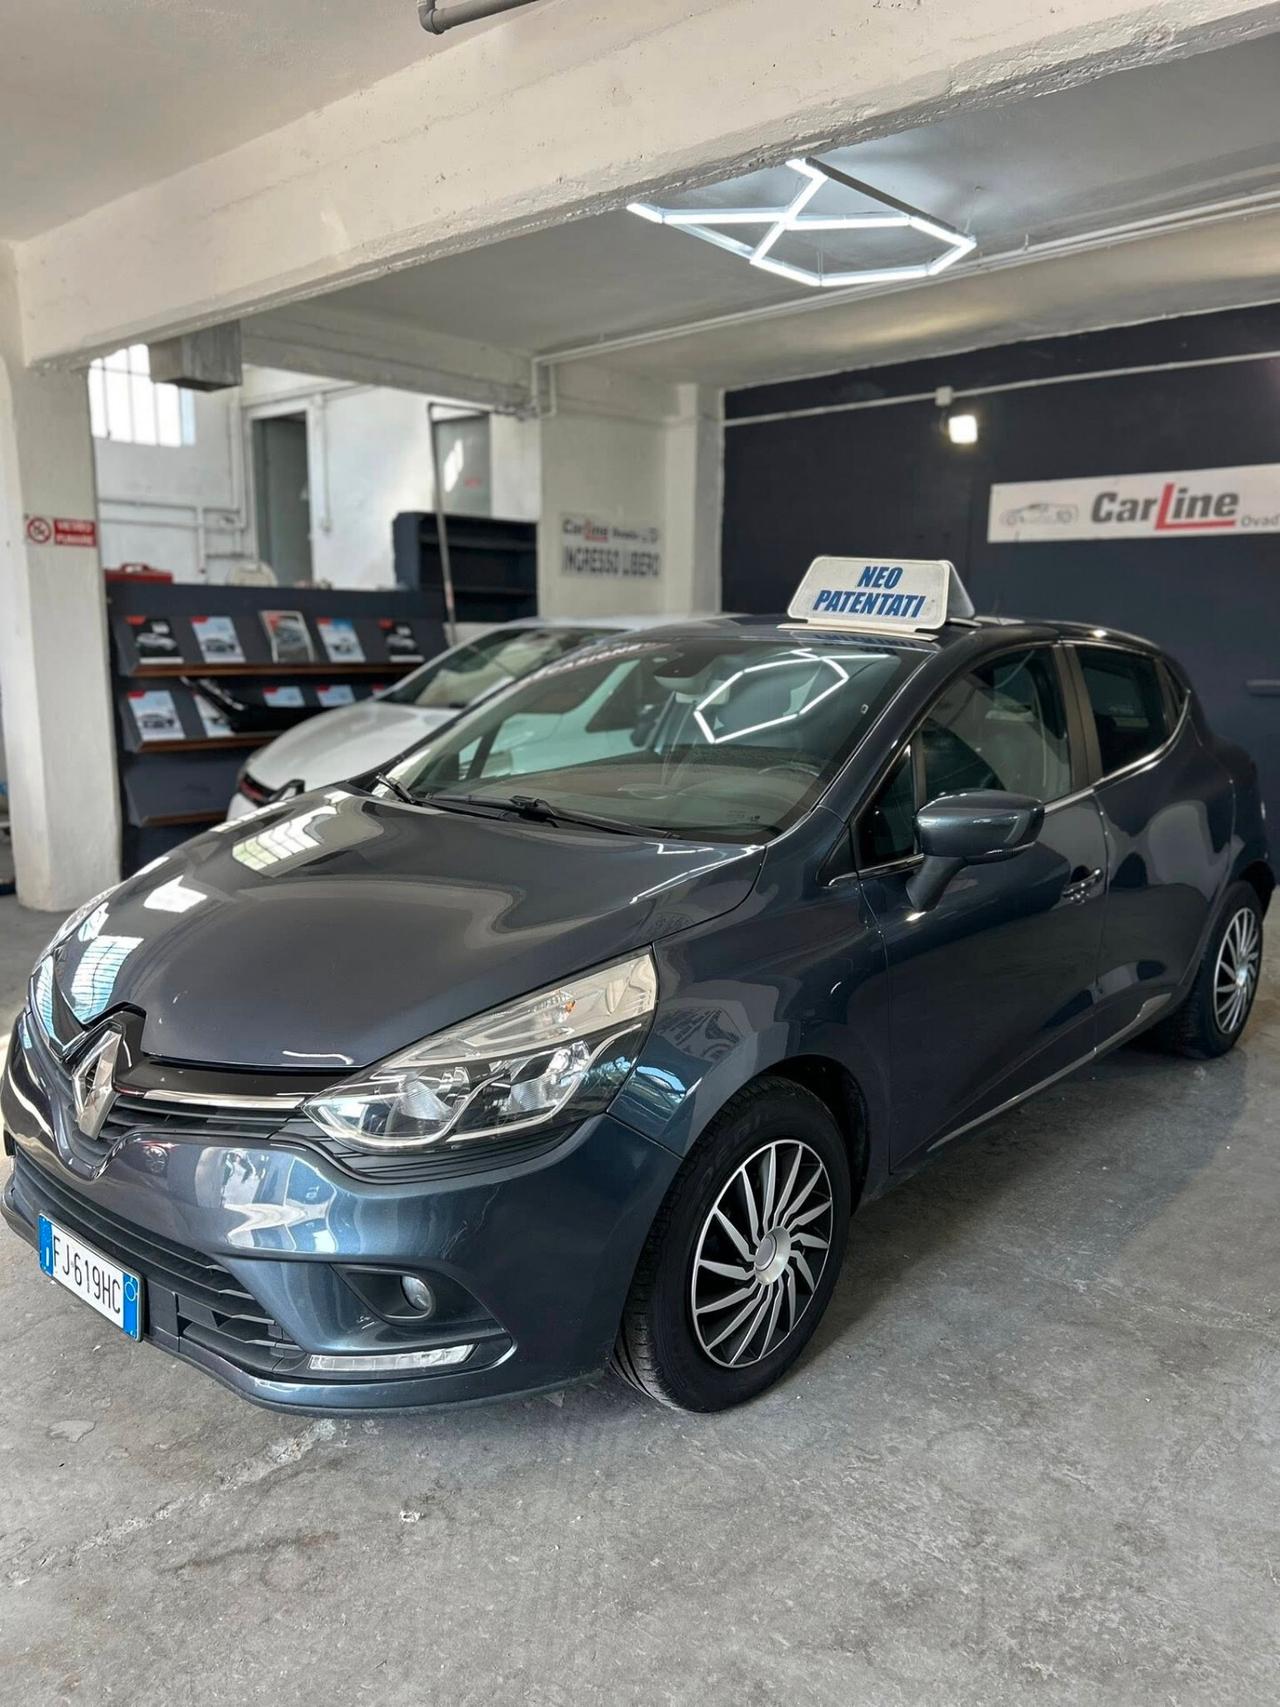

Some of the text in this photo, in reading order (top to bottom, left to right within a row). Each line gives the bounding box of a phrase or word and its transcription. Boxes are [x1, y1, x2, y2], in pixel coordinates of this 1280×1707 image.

[1091, 483, 1239, 530] CarLine
[857, 566, 903, 588] NEO
[813, 590, 926, 618] PATENTATI
[53, 1234, 121, 1314] FJ619HC
